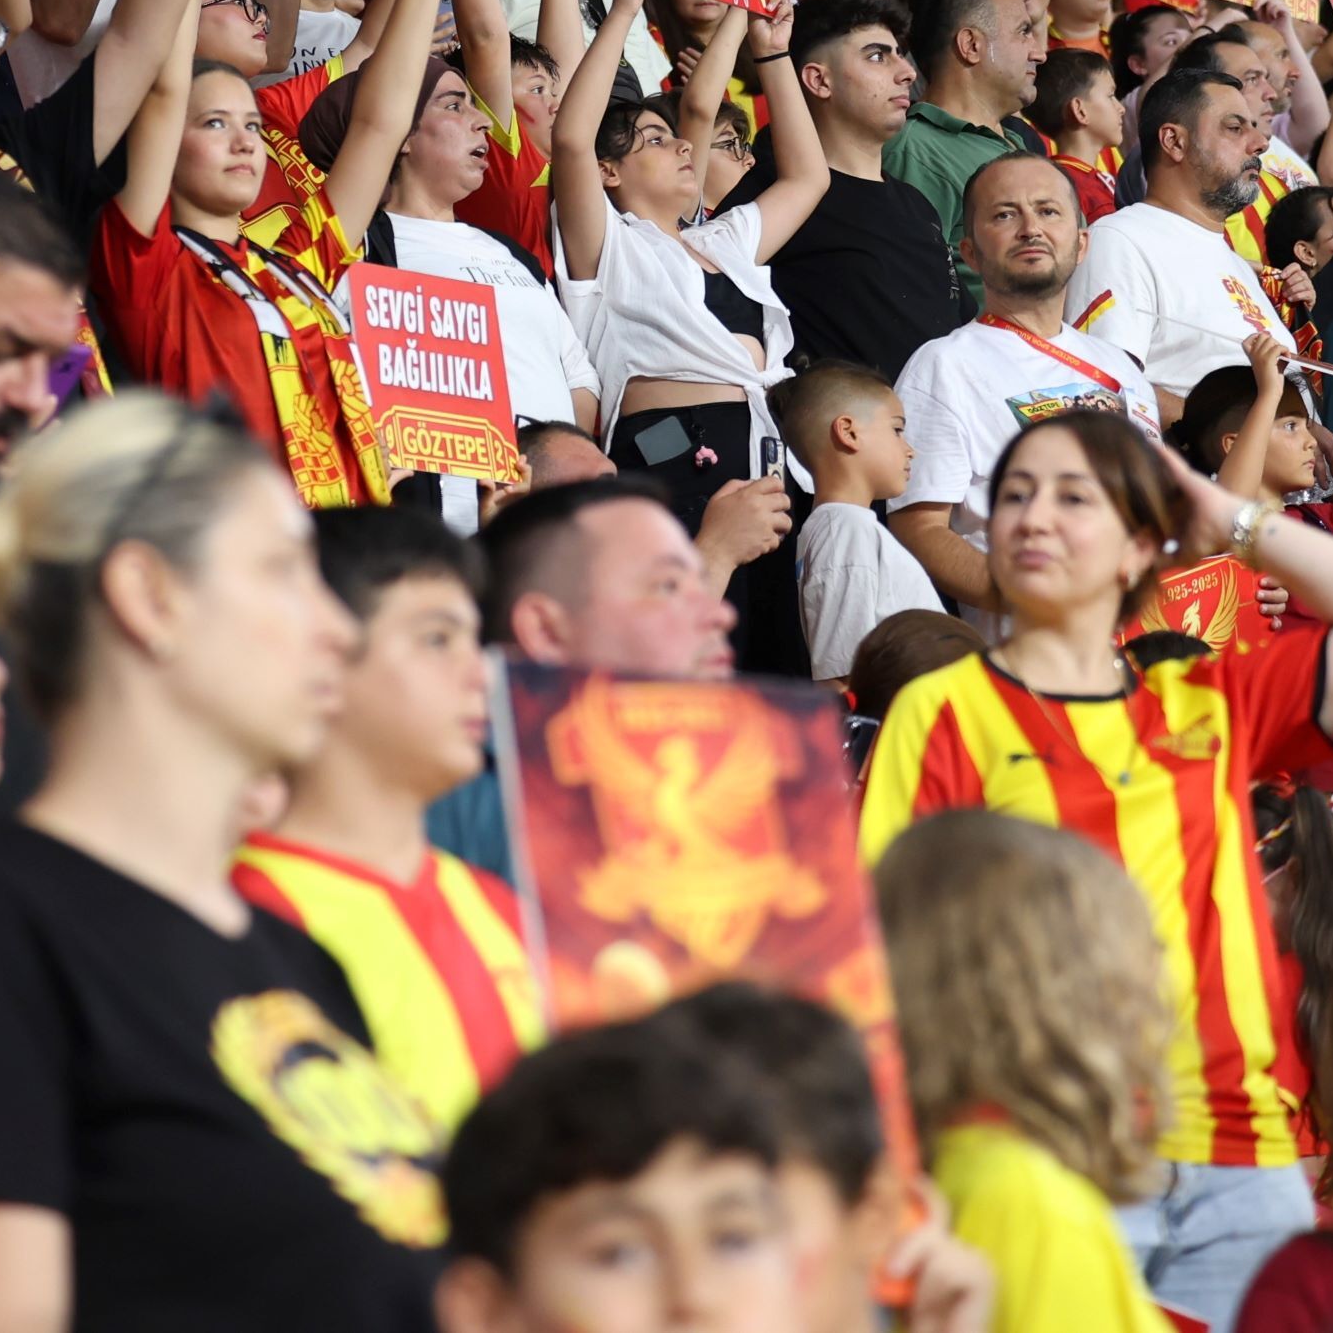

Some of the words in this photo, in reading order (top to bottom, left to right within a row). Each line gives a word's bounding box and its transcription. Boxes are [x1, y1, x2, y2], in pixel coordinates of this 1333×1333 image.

[365, 284, 425, 335] SEVGİ
[429, 296, 488, 345] SAYGI
[378, 338, 494, 402] BAĞLILIKLA
[402, 419, 488, 464] GÖZTEPE
